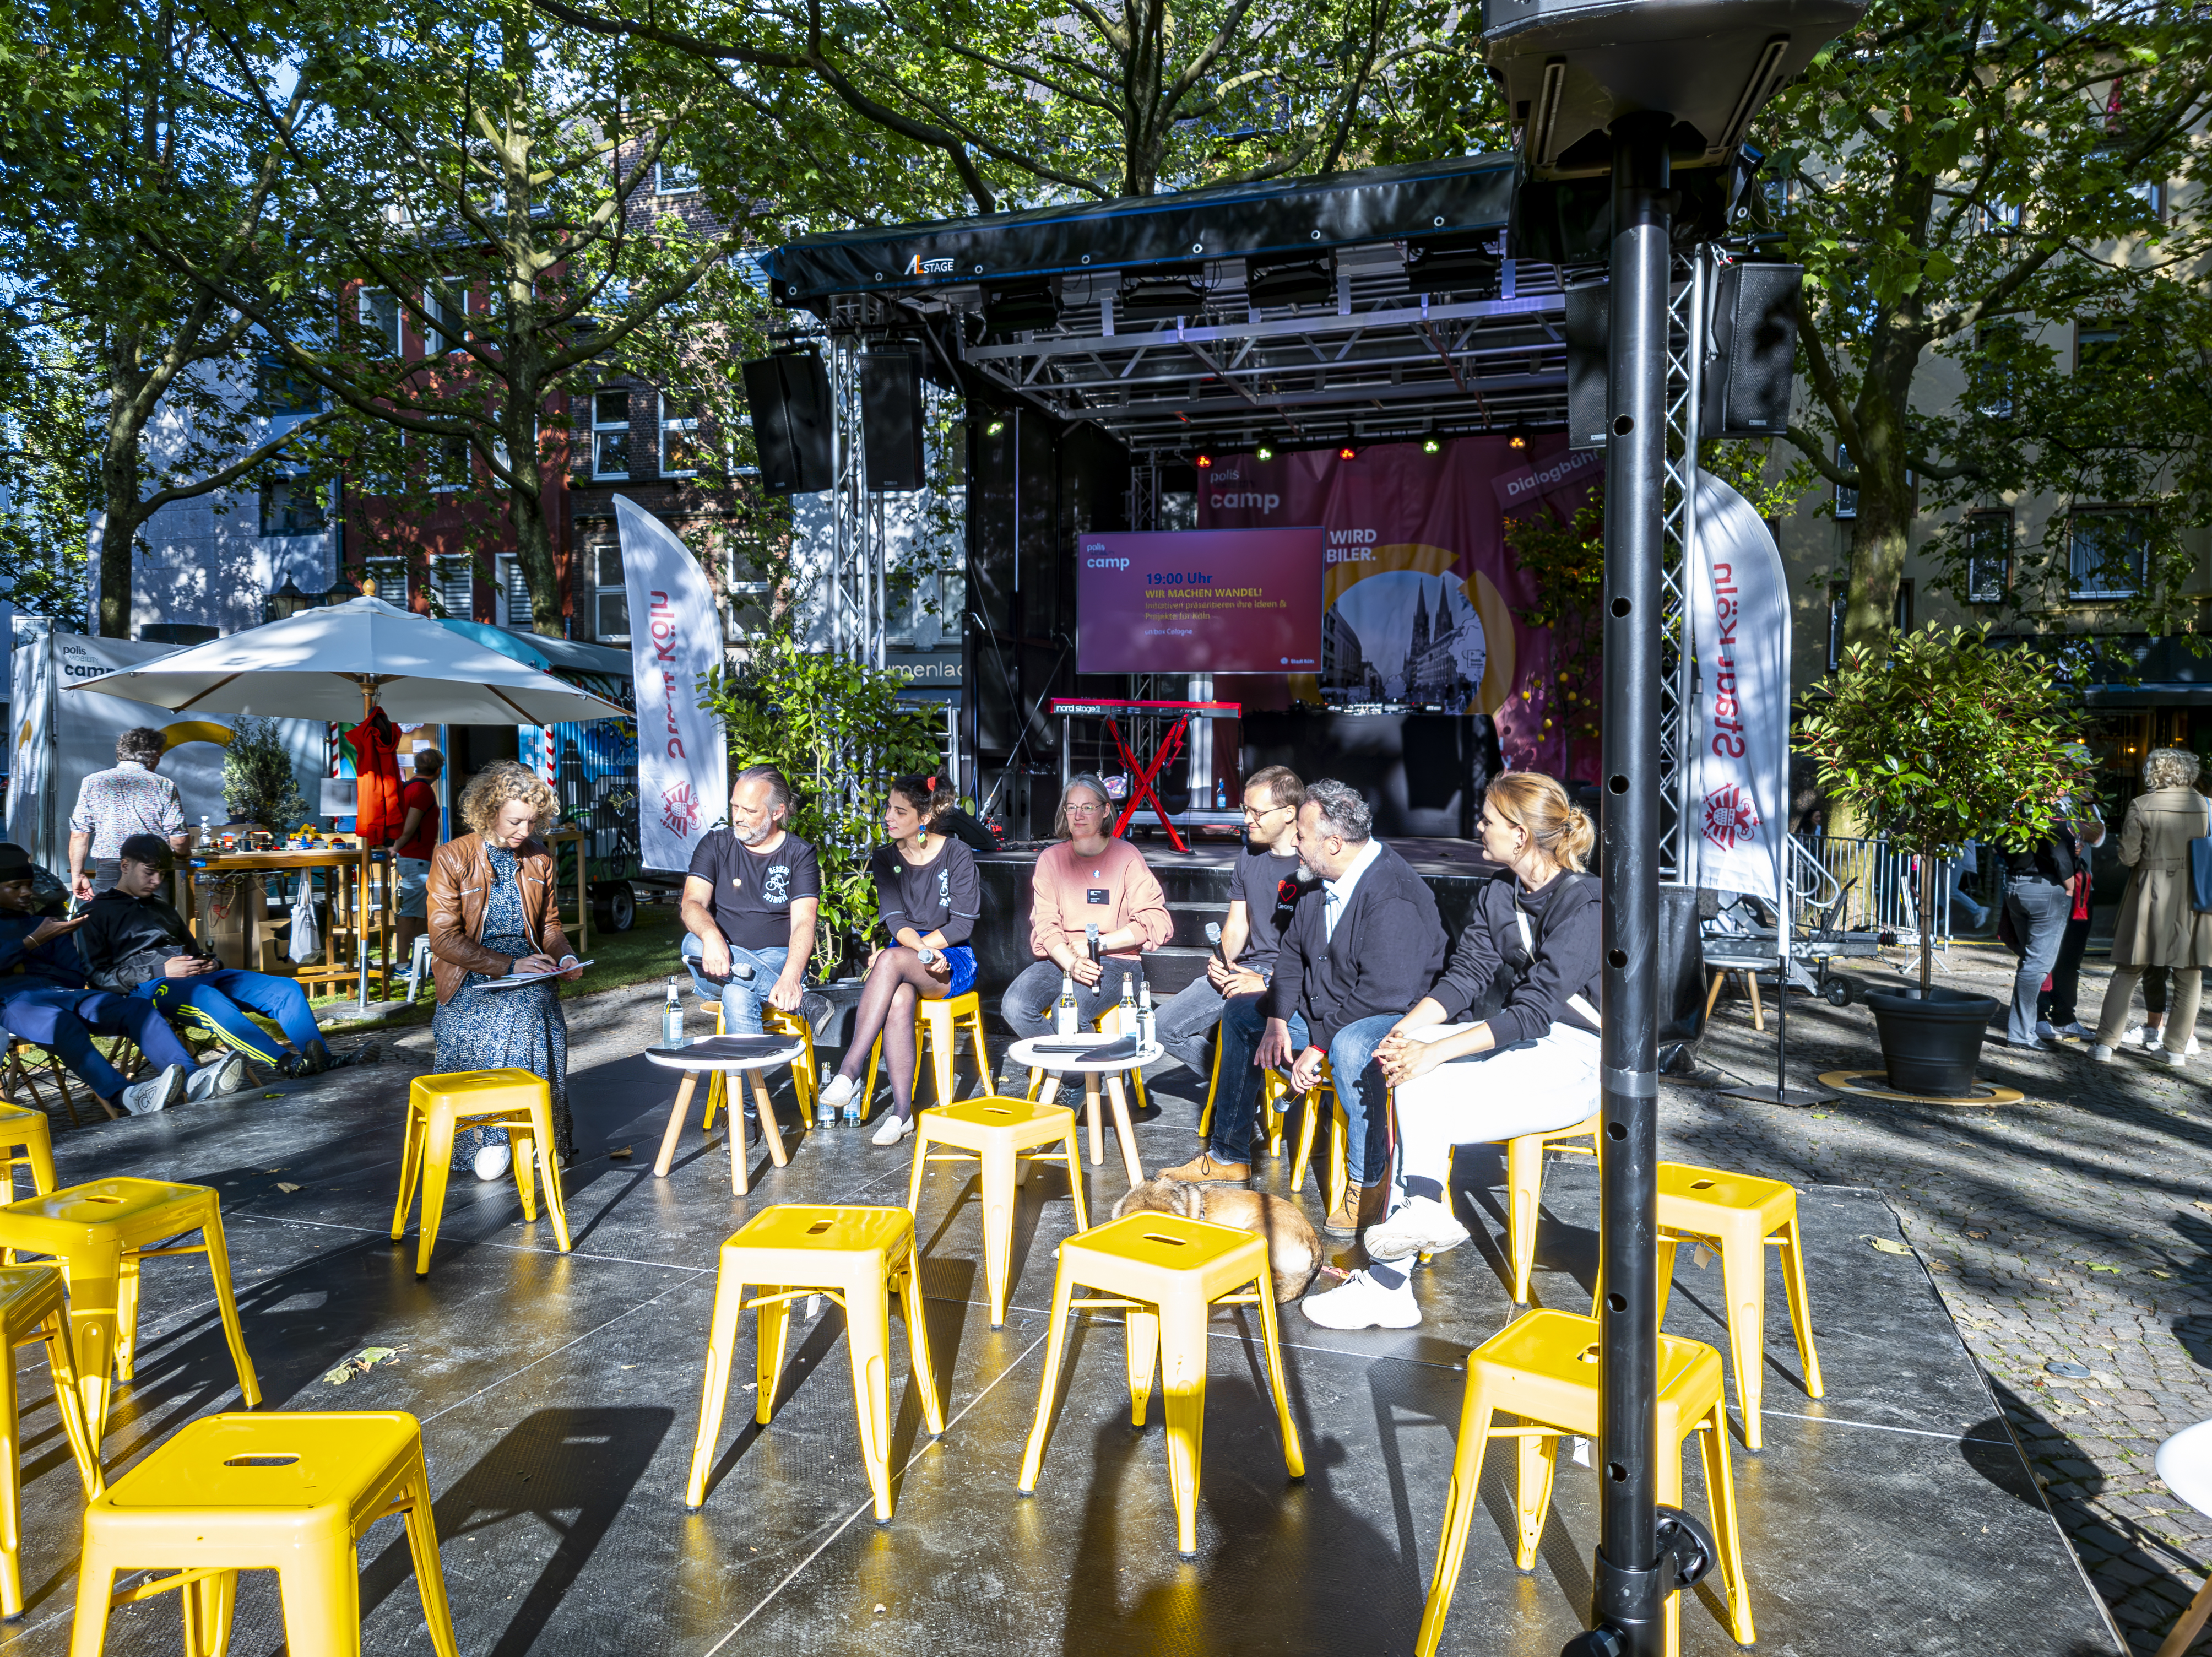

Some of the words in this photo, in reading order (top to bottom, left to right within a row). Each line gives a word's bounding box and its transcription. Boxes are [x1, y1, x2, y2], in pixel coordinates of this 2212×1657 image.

[924, 262, 953, 274] STAGE
[1210, 469, 1239, 484] polis
[1210, 492, 1280, 515] camp
[1330, 529, 1377, 545] WIRD
[1087, 543, 1105, 553] polis
[1324, 547, 1376, 563] BILER.
[1087, 557, 1130, 571] camp
[1146, 573, 1183, 584] 19:00
[1188, 572, 1213, 584] Uhr
[1145, 589, 1165, 598] WIR
[1168, 589, 1212, 598] MACHEN
[1215, 588, 1262, 597] WANDEL!
[63, 646, 86, 655] polis
[68, 654, 99, 664] MOBILITY
[1277, 902, 1293, 912] Georg
